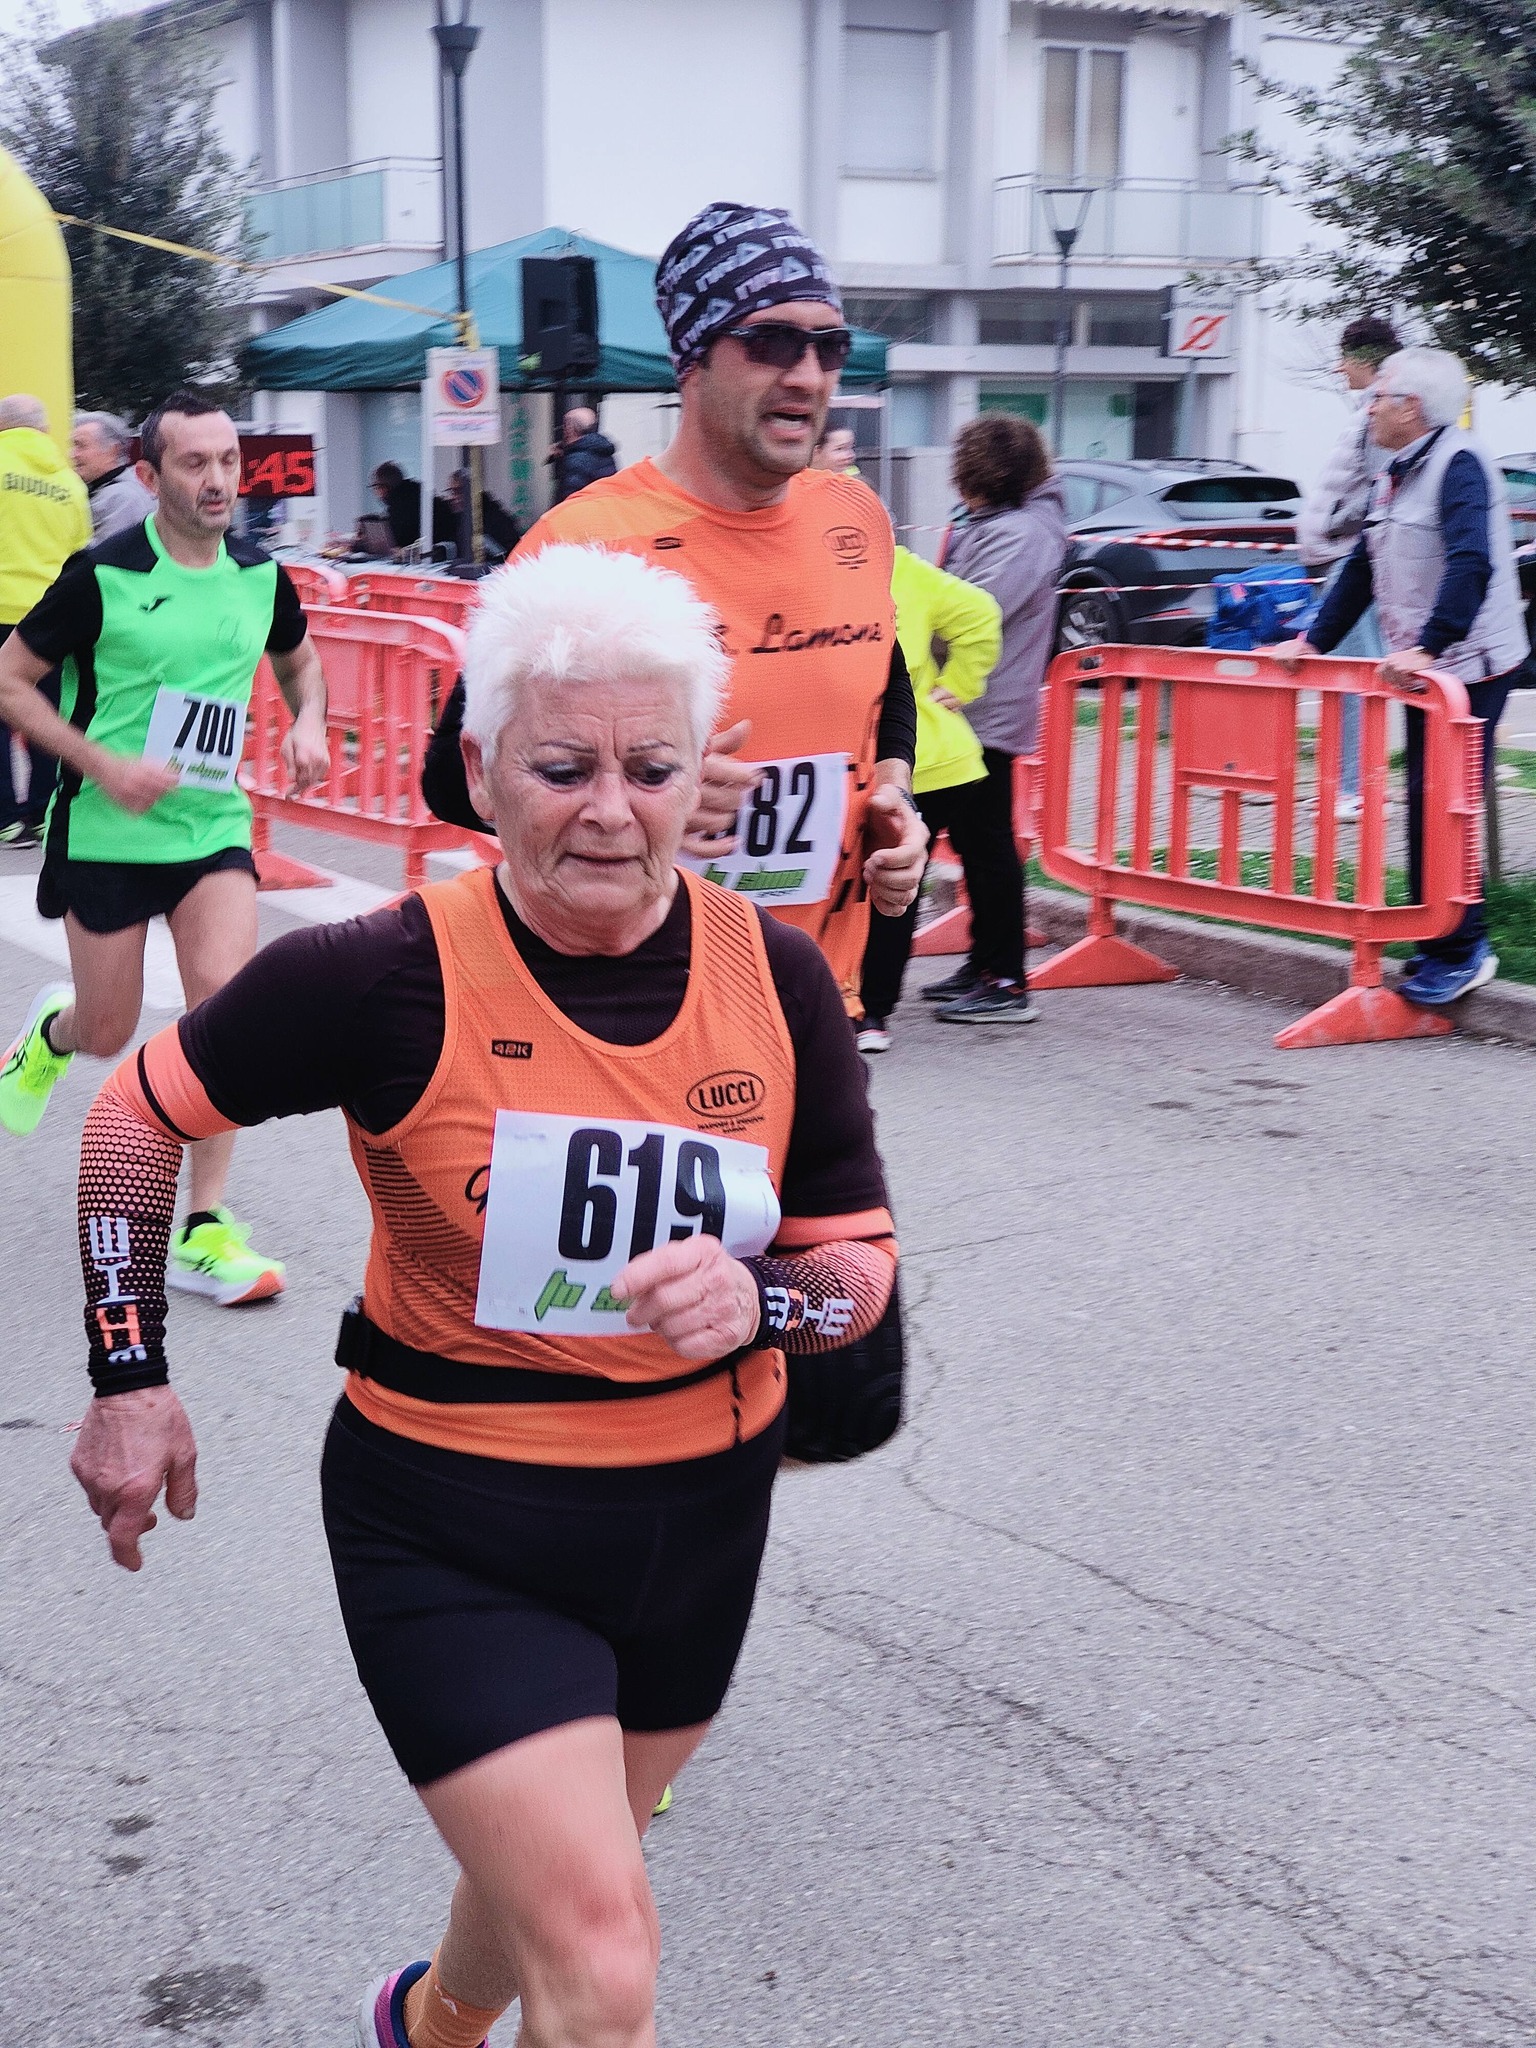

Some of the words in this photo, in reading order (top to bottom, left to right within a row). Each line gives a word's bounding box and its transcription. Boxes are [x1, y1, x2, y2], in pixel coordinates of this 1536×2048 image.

[173, 695, 236, 757] 700
[705, 761, 815, 858] 82
[697, 1079, 757, 1111] LUCCI
[557, 1127, 727, 1264] 619
